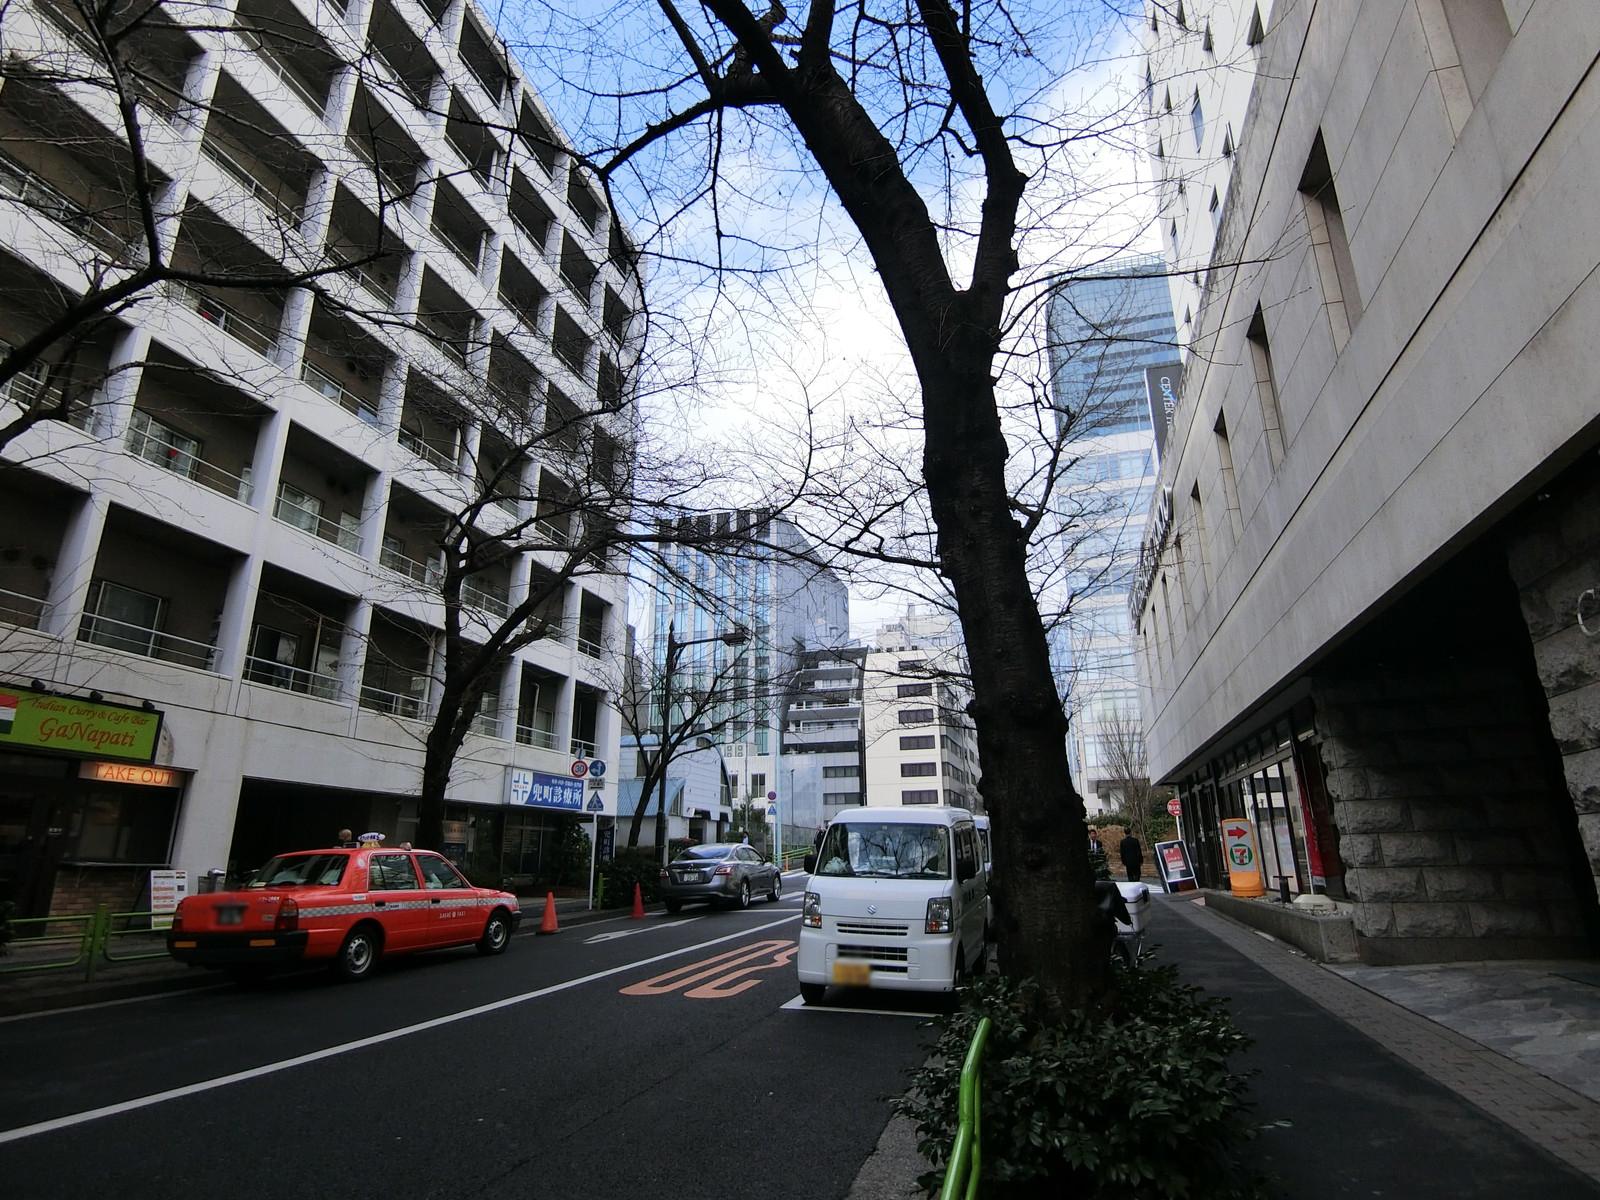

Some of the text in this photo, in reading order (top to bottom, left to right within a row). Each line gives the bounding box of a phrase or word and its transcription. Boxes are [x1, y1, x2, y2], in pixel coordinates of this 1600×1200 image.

[32, 699, 67, 713] Indian
[69, 705, 97, 720] Curry
[98, 711, 107, 719] &
[131, 714, 149, 725] Bar
[39, 718, 137, 749] GaNapati
[94, 764, 174, 785] TAKE OUT
[575, 765, 585, 773] 30
[533, 783, 582, 806] 兜町診療所
